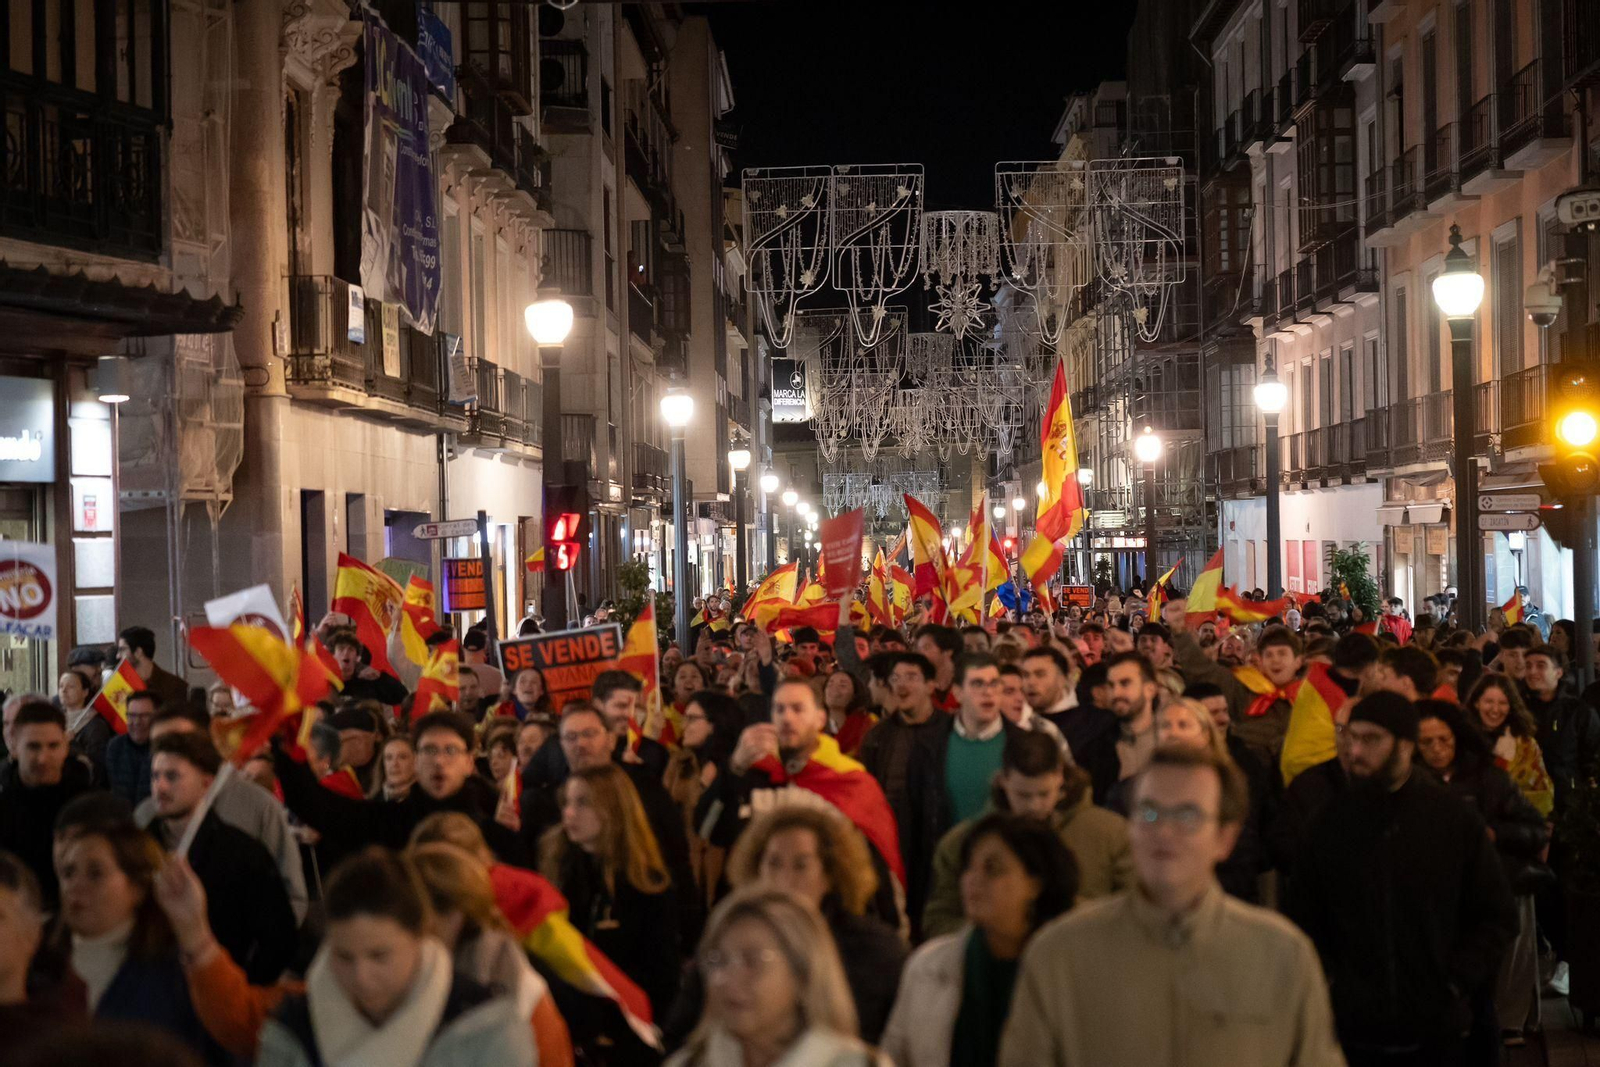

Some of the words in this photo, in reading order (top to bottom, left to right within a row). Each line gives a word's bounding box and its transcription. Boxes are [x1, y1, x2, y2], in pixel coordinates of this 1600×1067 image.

[774, 389, 796, 398] MARCA
[797, 389, 805, 398] LA
[451, 561, 483, 577] VEND
[0, 583, 44, 613] NO
[504, 643, 535, 671] SE
[538, 631, 616, 666] VENDE
